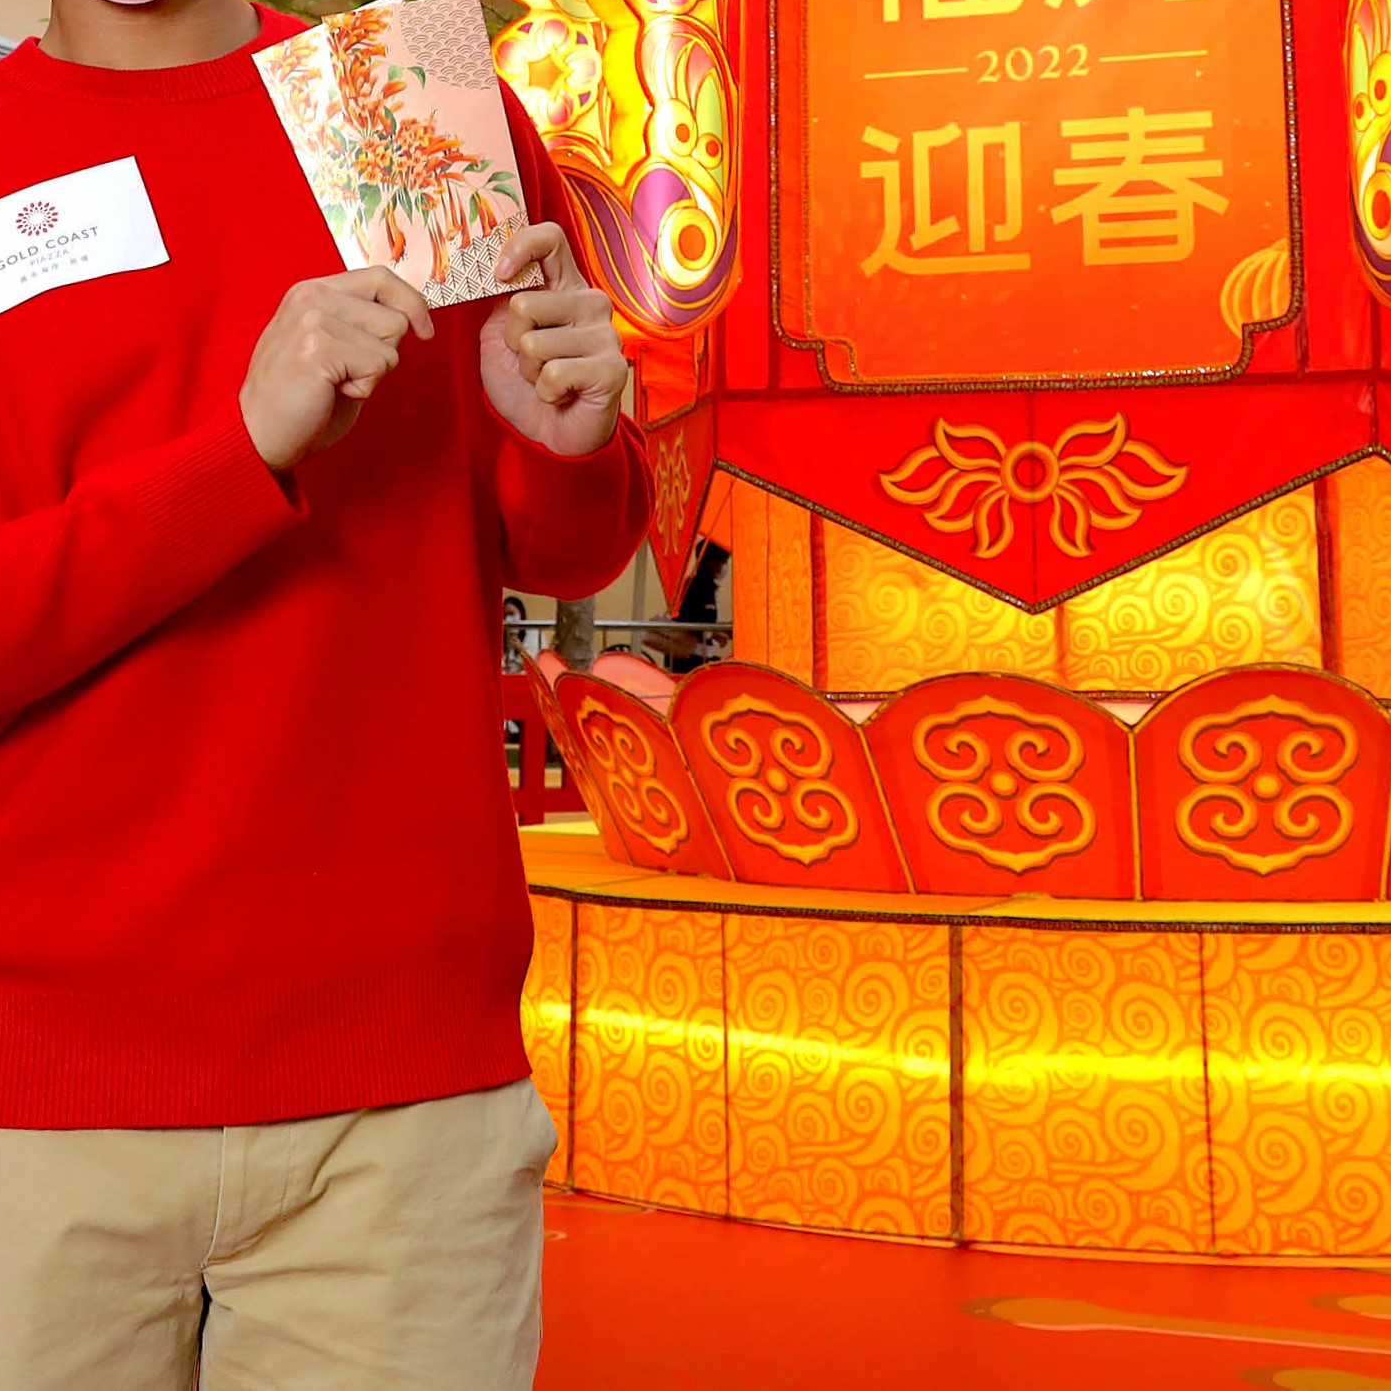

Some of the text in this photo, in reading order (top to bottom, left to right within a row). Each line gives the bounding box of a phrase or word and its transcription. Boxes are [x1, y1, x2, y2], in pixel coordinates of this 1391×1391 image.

[975, 43, 1091, 83] 2022
[859, 106, 1230, 278] 迎春
[45, 226, 98, 249] COAST
